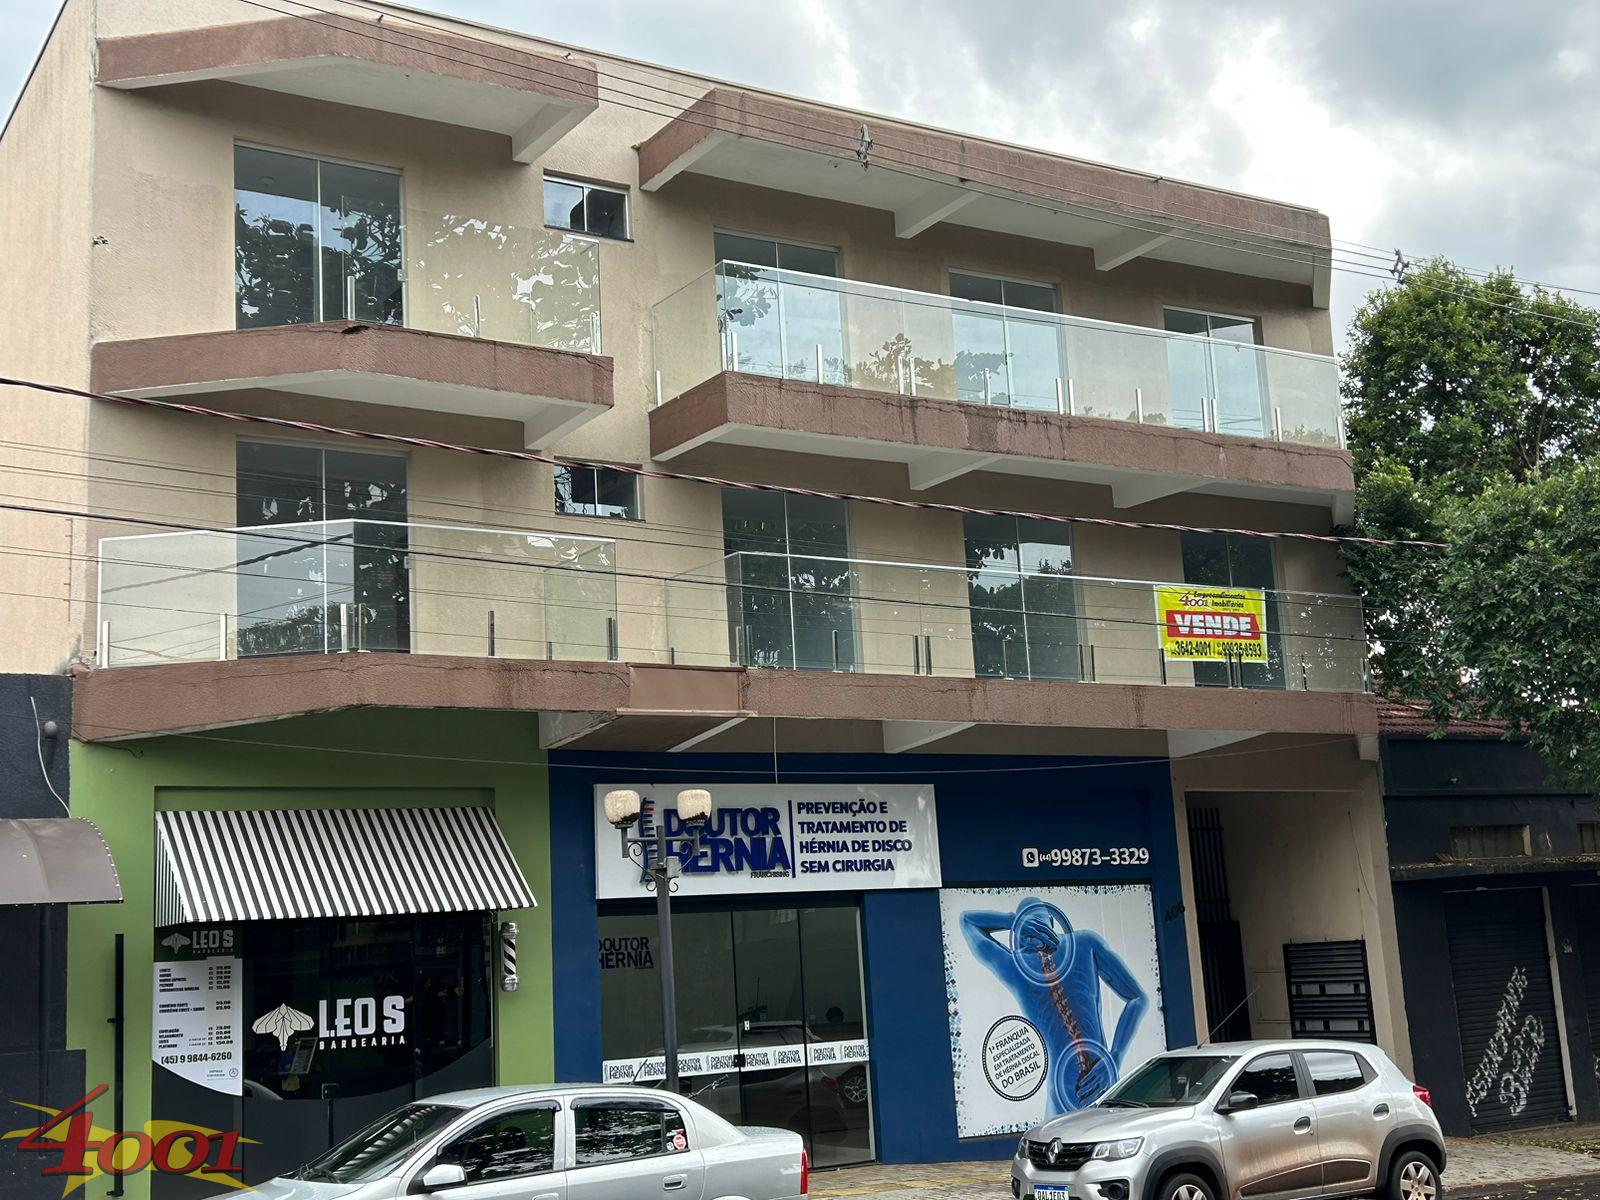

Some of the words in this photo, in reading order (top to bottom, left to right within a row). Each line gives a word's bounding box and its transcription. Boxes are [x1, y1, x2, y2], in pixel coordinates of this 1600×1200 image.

[1174, 614, 1252, 636] VENDE
[797, 799, 877, 817] PREVENÇÃO
[880, 801, 888, 814] E
[798, 821, 887, 834] TRATAMENTO
[889, 820, 907, 833] DE
[800, 837, 850, 853] HÉRNIA
[851, 840, 870, 853] DE
[872, 839, 912, 852] DISCO
[800, 860, 830, 873] SEM
[832, 859, 895, 872] CIRURGIA
[319, 1035, 406, 1050] BARBEARIA
[995, 1026, 1029, 1050] FRANQUIA
[161, 1056, 178, 1064] (45)
[180, 1055, 185, 1063] 9
[187, 1052, 232, 1062] 9844-6260
[992, 1036, 1030, 1062] ESPECIALIZADA
[994, 1061, 1002, 1071] EM
[1002, 1043, 1036, 1066] TRATAMENTO
[994, 1071, 1003, 1080] DE
[1022, 1050, 1040, 1064] DISCAL
[1002, 1076, 1014, 1088] DO
[1014, 1060, 1041, 1081] BRASIL
